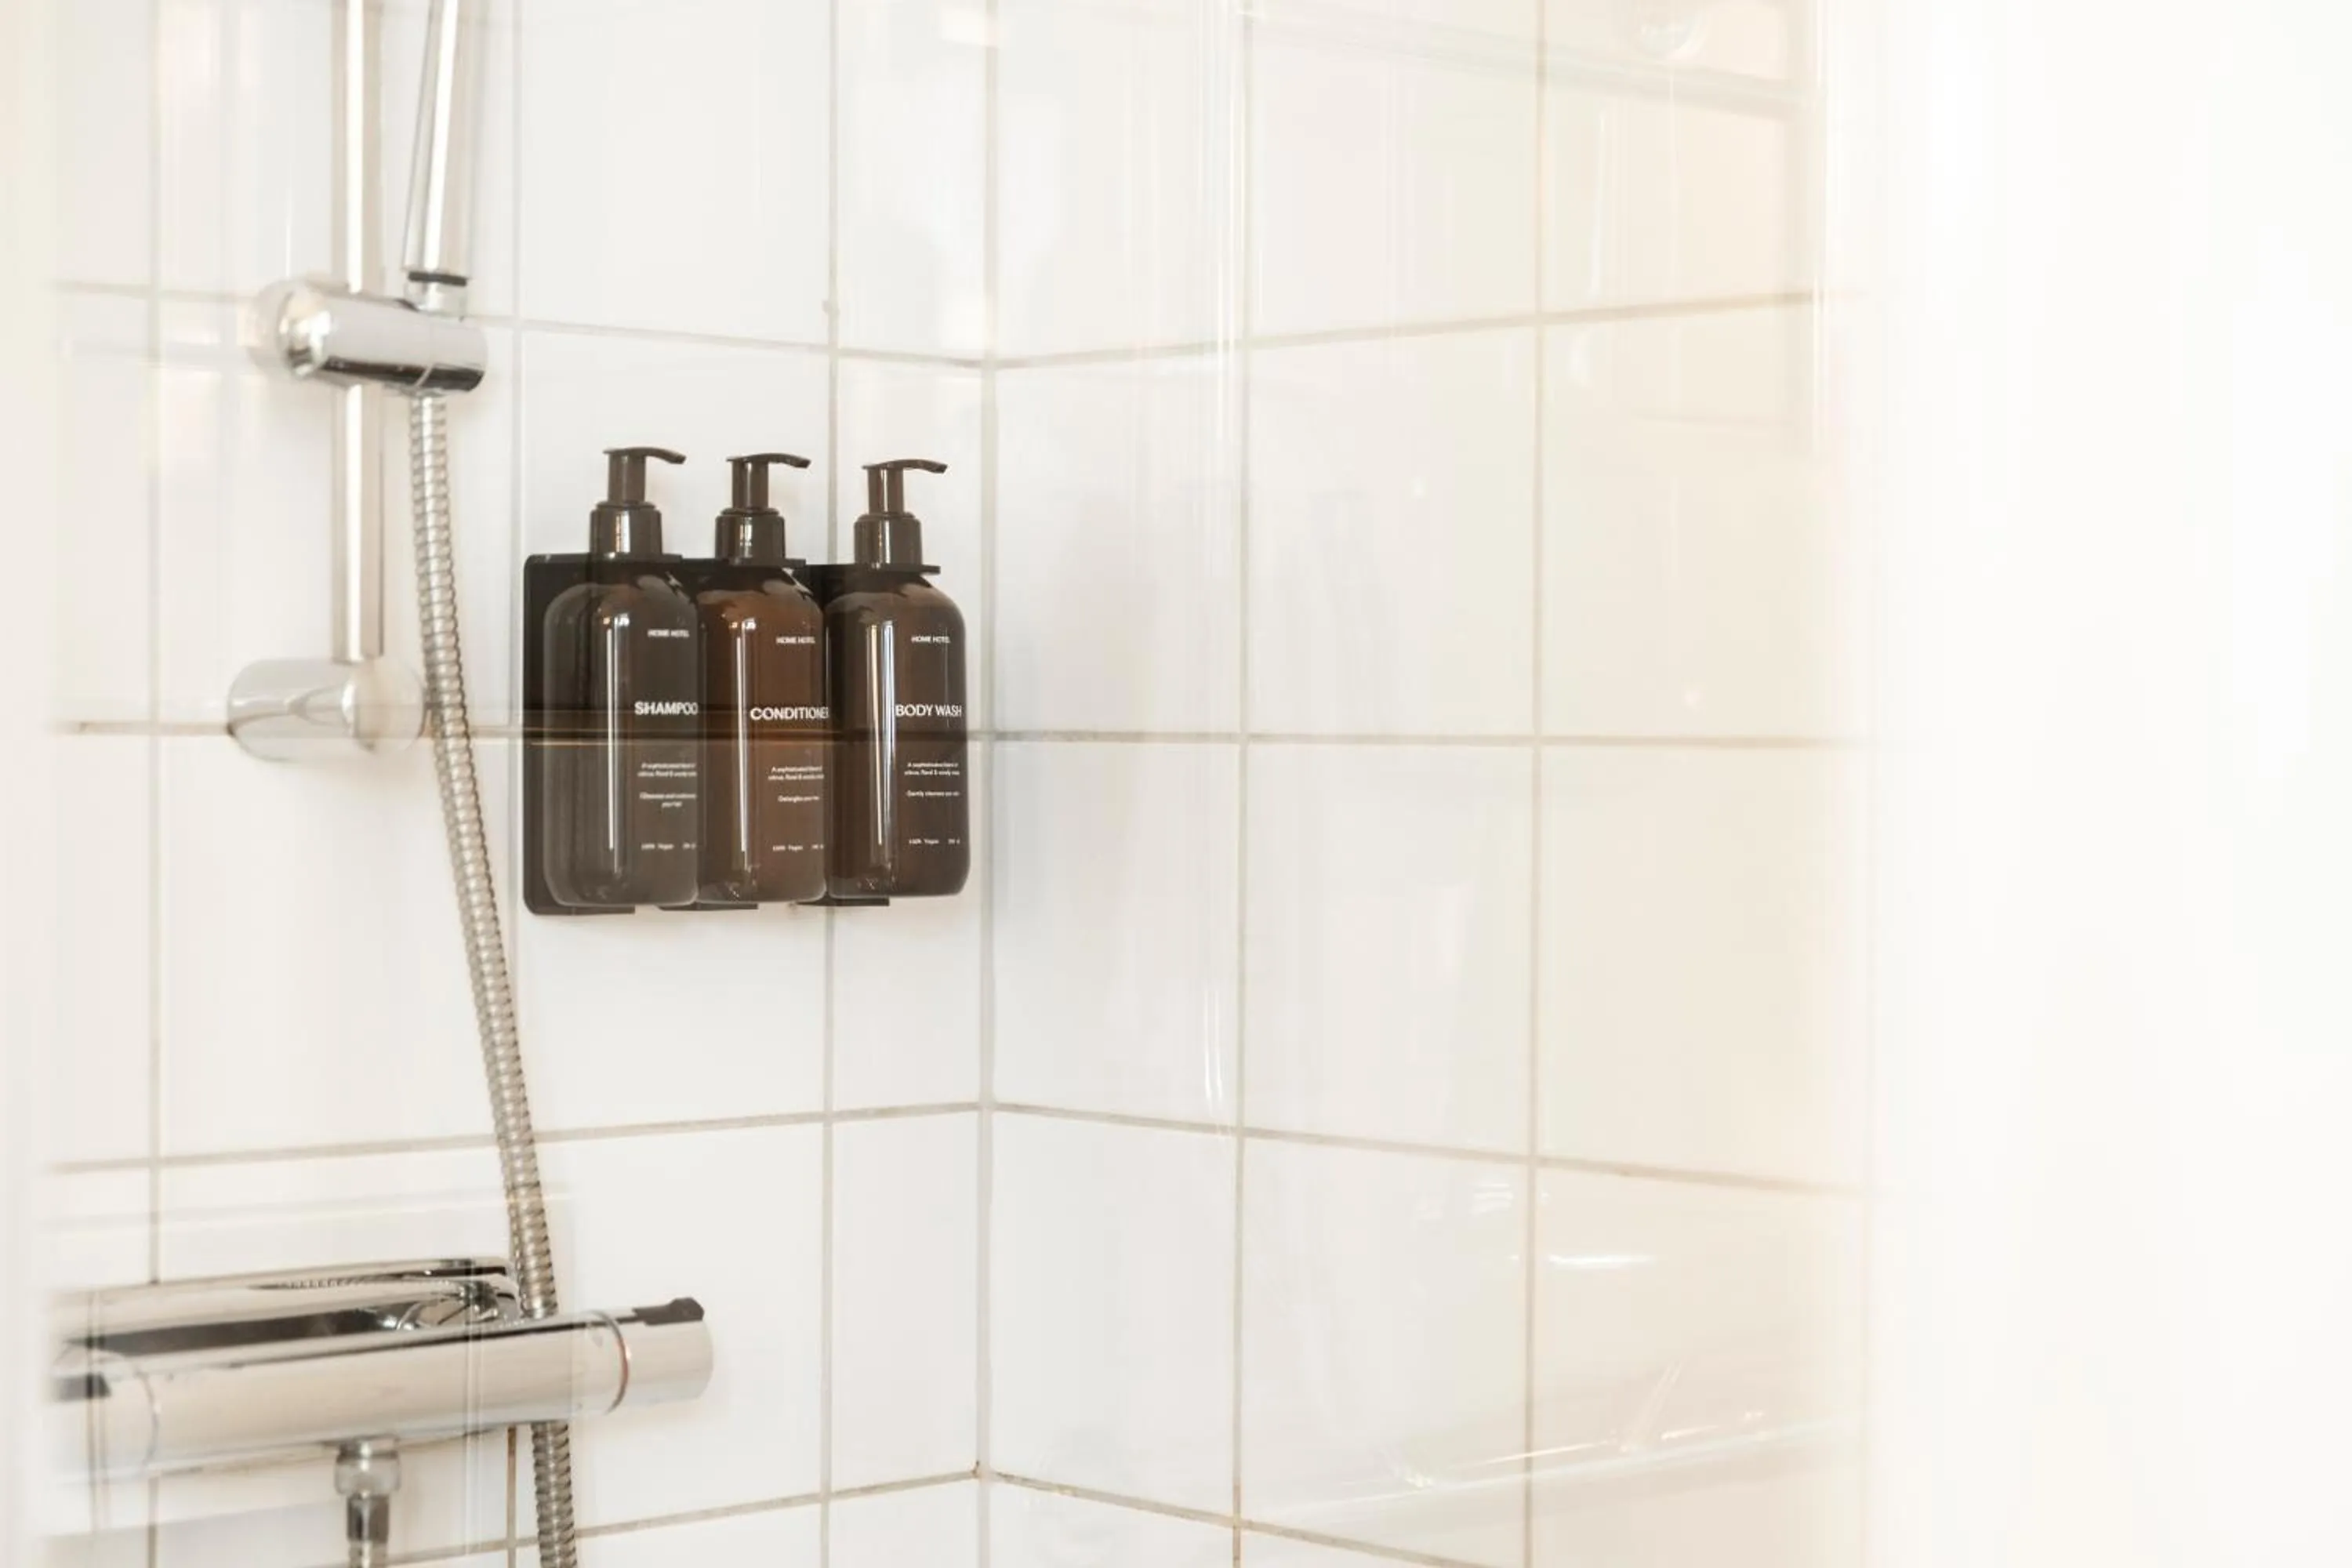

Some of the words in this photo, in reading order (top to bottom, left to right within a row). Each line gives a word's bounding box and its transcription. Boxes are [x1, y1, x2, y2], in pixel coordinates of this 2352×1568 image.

[633, 701, 699, 715] SHAMPOO
[750, 706, 830, 720] CONDITIONE
[895, 704, 934, 717] BODY
[934, 705, 963, 718] WASH
